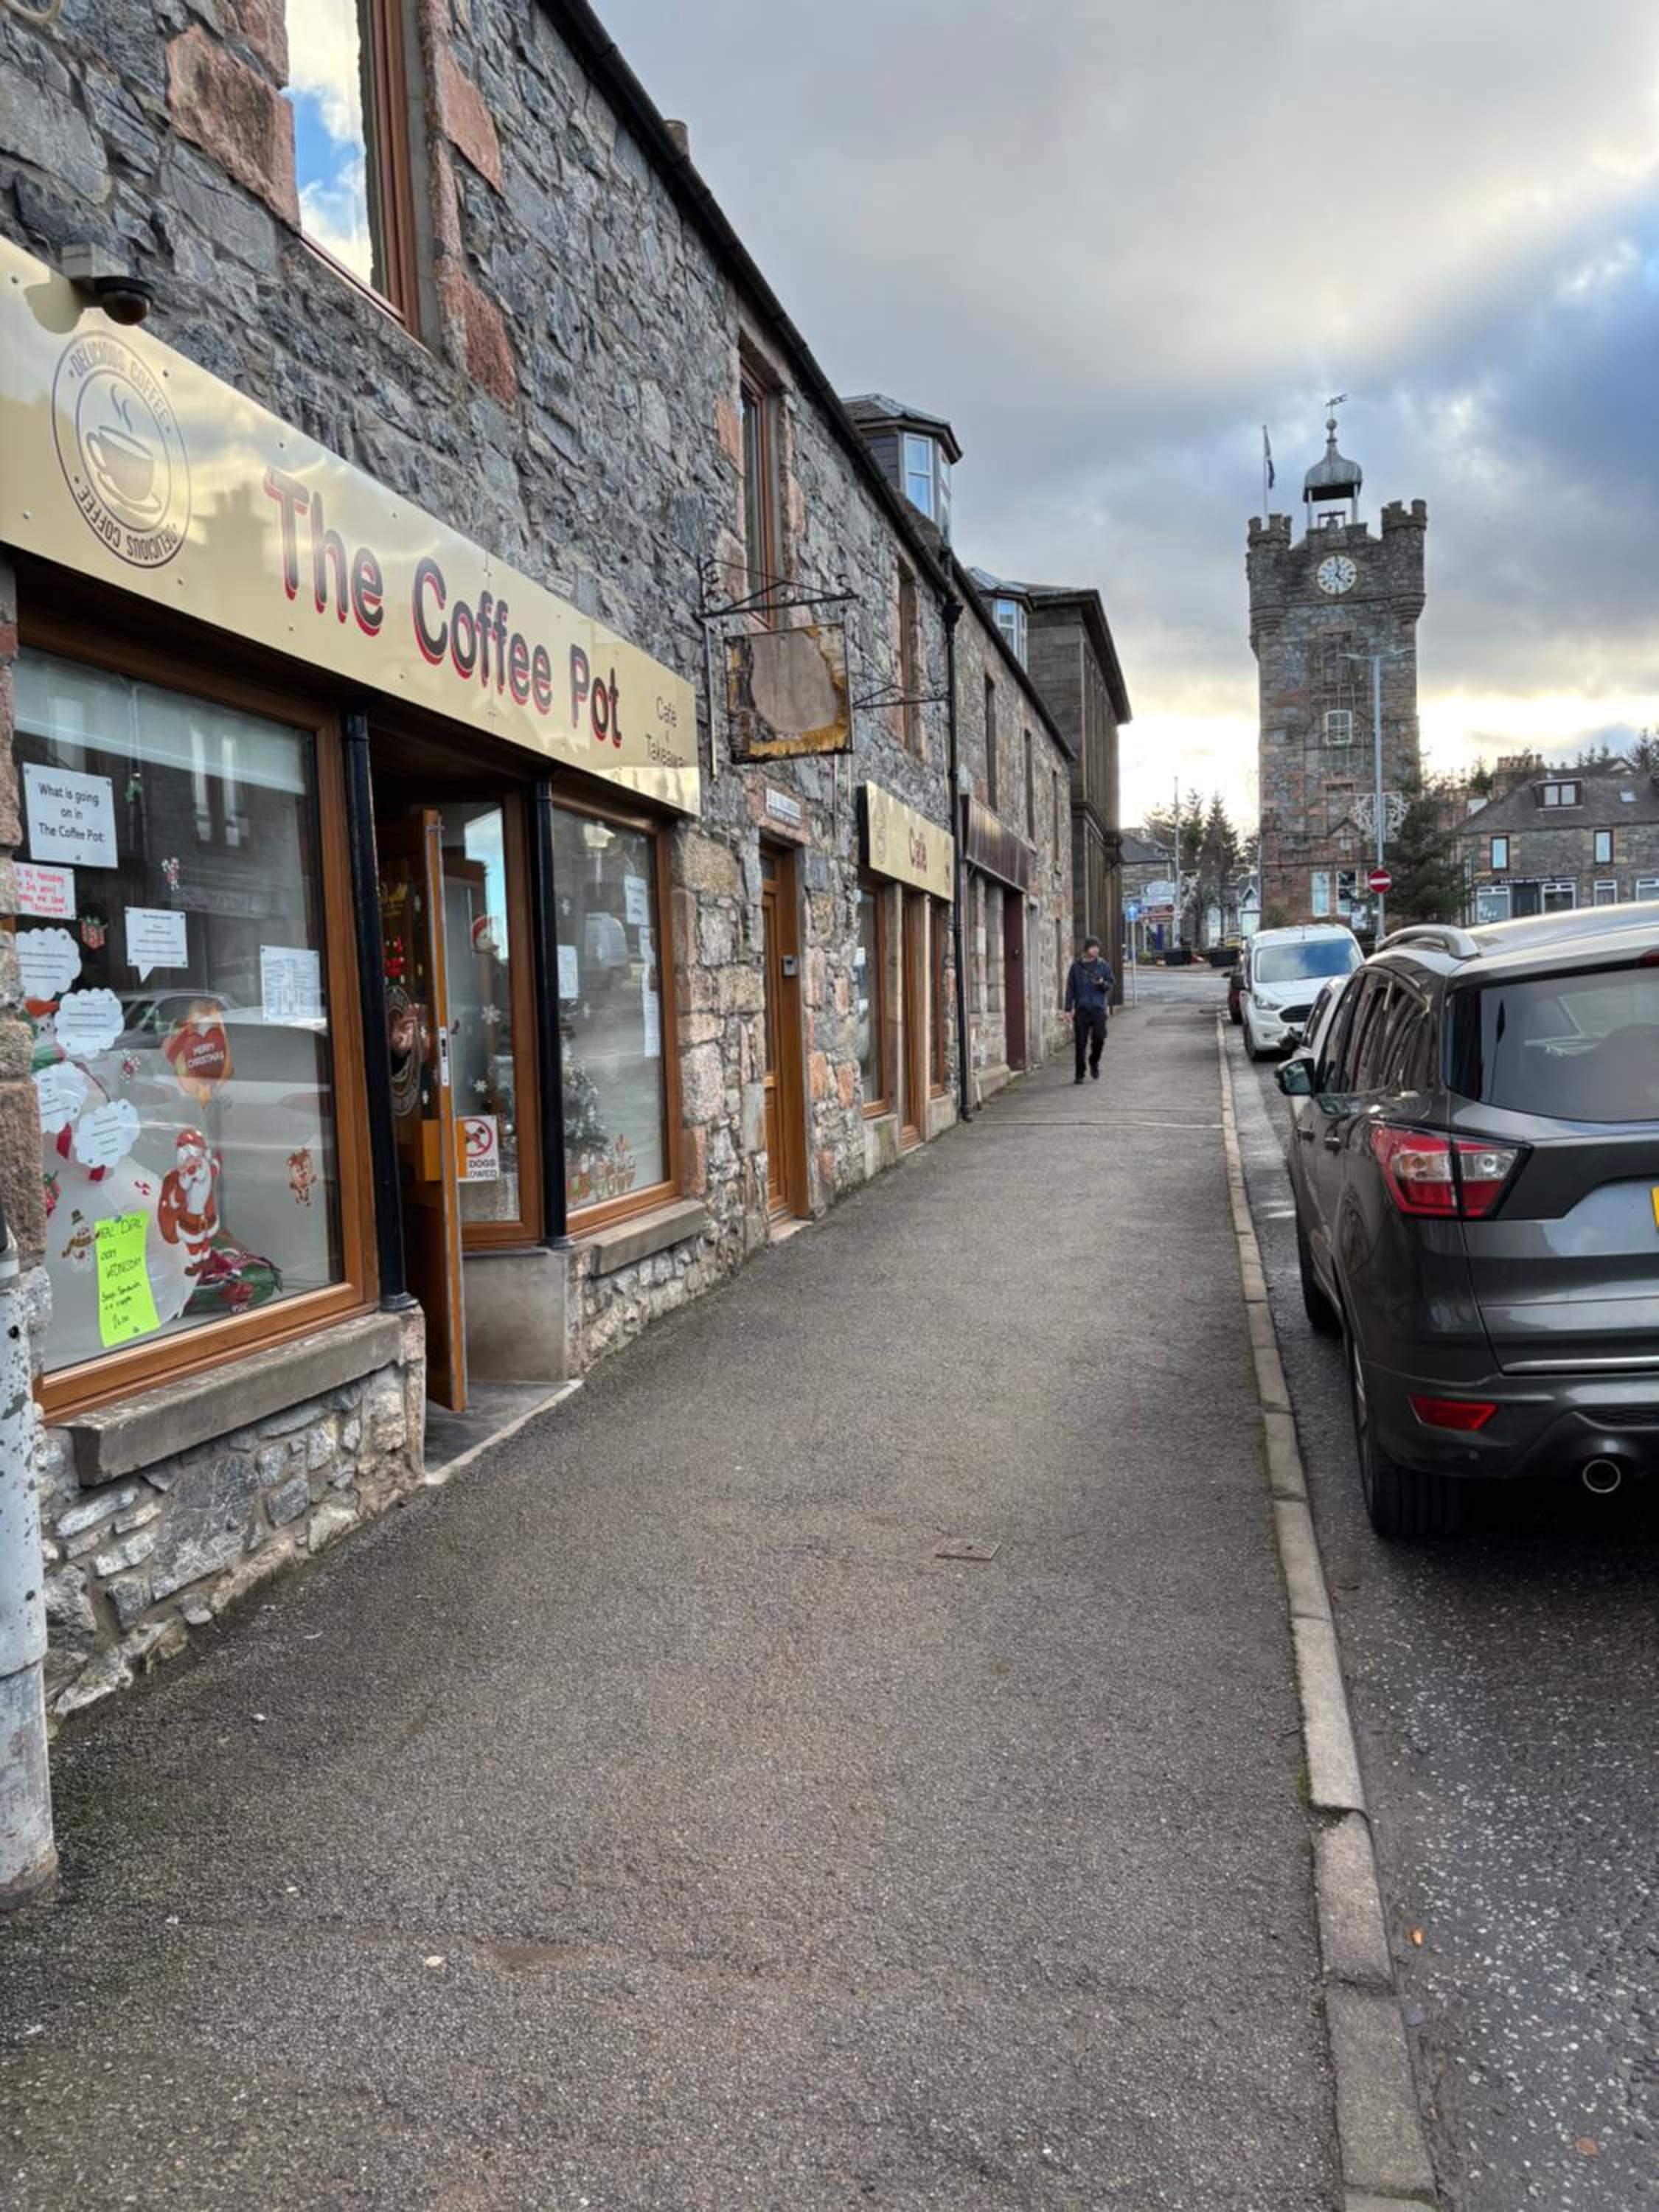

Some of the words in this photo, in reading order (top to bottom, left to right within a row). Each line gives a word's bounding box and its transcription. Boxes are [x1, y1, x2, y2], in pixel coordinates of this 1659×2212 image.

[77, 485, 122, 549] COFFEE
[262, 465, 384, 637] The
[411, 556, 553, 715] Coffee
[569, 643, 623, 749] Pot
[38, 782, 63, 798] What
[65, 787, 73, 800] is
[74, 791, 100, 807] going
[60, 808, 72, 818] on
[74, 808, 83, 820] in
[38, 821, 57, 837] The
[58, 825, 86, 841] Coffee
[468, 1158, 496, 1169] DOGS
